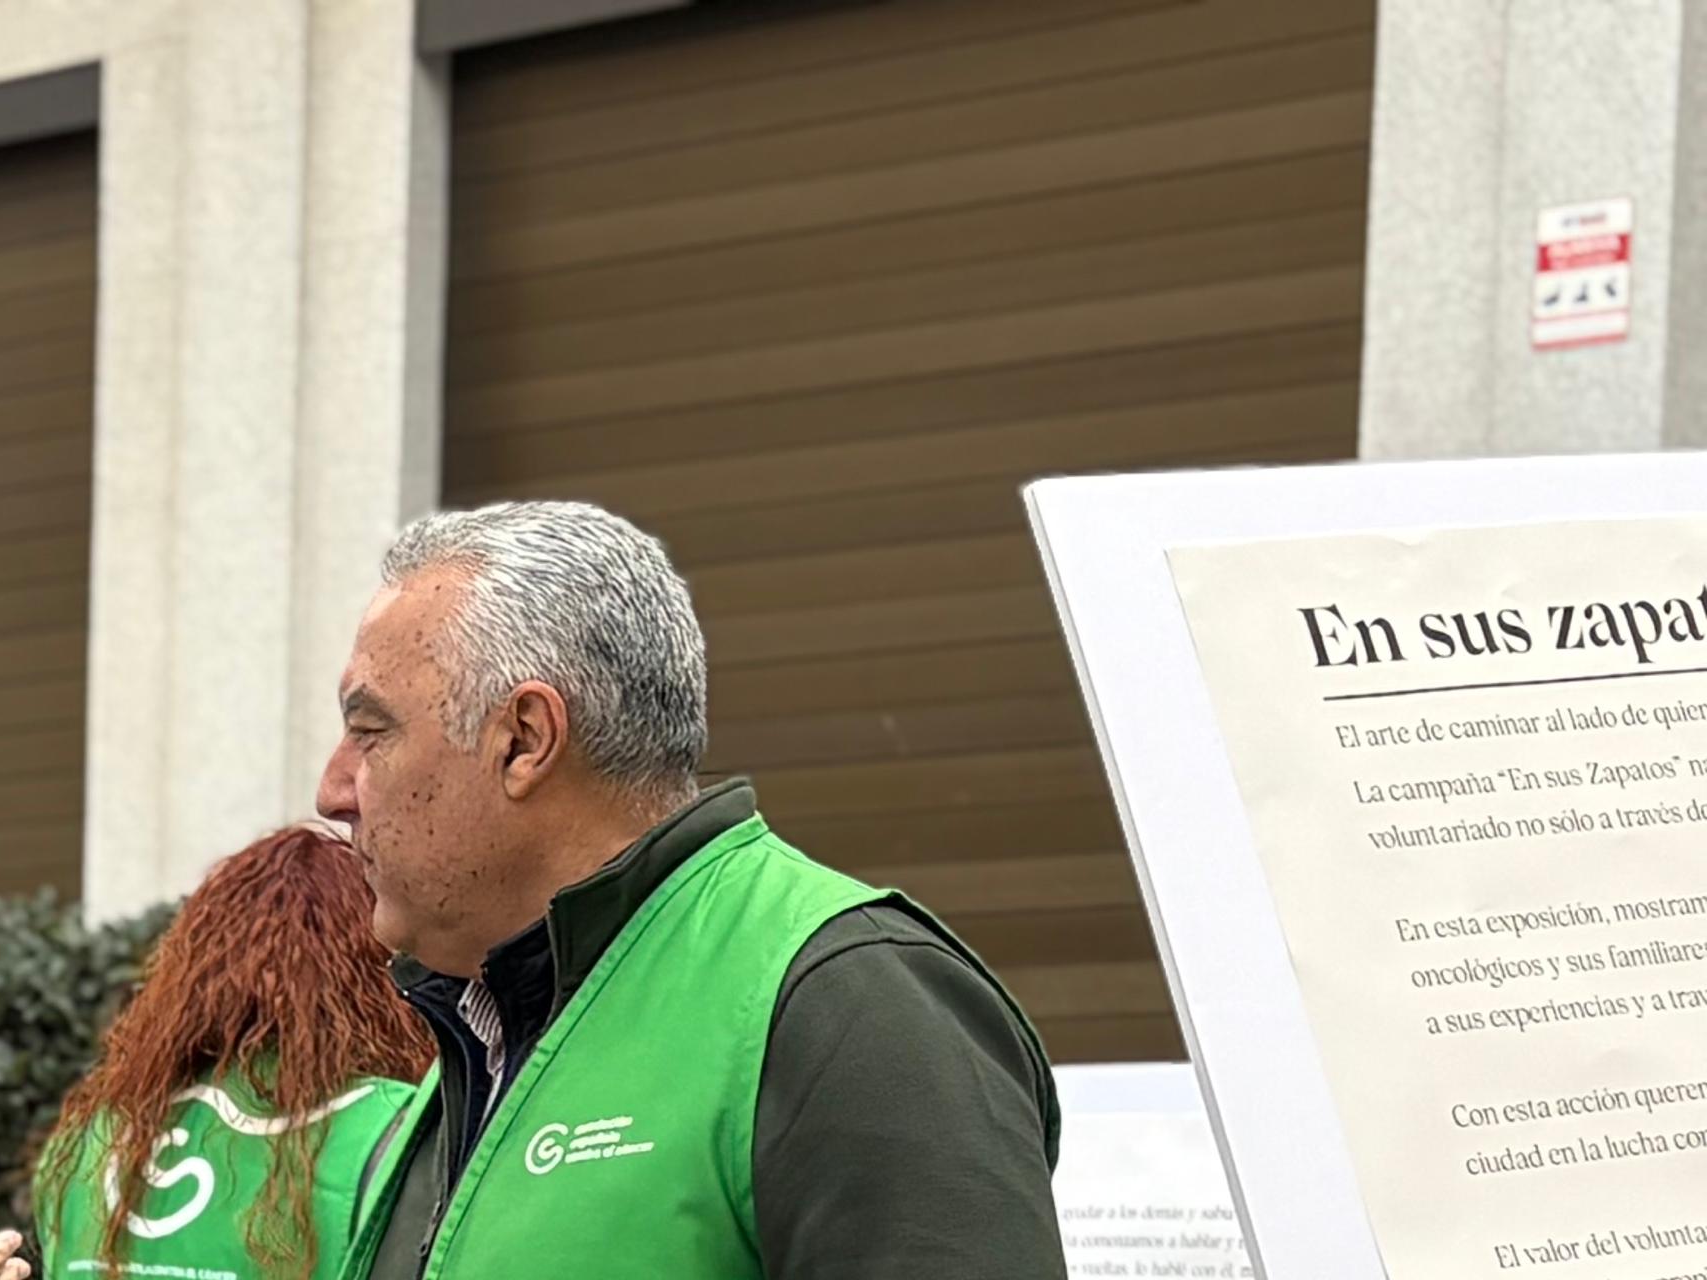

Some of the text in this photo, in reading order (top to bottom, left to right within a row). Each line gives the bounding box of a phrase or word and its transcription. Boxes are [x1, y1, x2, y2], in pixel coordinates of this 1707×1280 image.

[1297, 603, 1408, 666] En
[1419, 609, 1532, 659] sus
[1336, 724, 1360, 748] El
[1367, 726, 1411, 748] arte
[1416, 718, 1444, 744] de
[1449, 713, 1540, 740] caminar
[1546, 708, 1565, 732] al
[1568, 705, 1617, 731] lado
[1622, 703, 1648, 726] de
[1354, 780, 1383, 804] La
[1388, 772, 1497, 804] campaña
[1544, 766, 1583, 789] sus
[1368, 815, 1512, 850] voluntariado
[1516, 816, 1546, 837] no
[1549, 808, 1595, 834] sólo
[1599, 810, 1613, 830] a
[1617, 801, 1684, 828] través
[1395, 918, 1430, 942] En
[1433, 916, 1483, 938] esta
[1486, 902, 1611, 938] exposición,
[1411, 957, 1544, 988] oncológicos
[1547, 955, 1560, 980] y
[1566, 951, 1605, 973] sus
[1426, 1016, 1442, 1035] a
[1445, 1011, 1485, 1033] sus
[1489, 994, 1630, 1033] experiencias
[1631, 994, 1645, 1018] y
[1651, 992, 1666, 1012] a
[1451, 1103, 1500, 1128] Con
[1503, 1099, 1552, 1123] esta
[1556, 1088, 1631, 1117] acción
[1465, 1144, 1545, 1175] ciudad
[1548, 1145, 1578, 1166] en
[1579, 1137, 1603, 1162] la
[1604, 1131, 1669, 1159] lucha
[1494, 1243, 1521, 1269] El
[1524, 1238, 1580, 1264] valor
[1585, 1230, 1622, 1257] del
